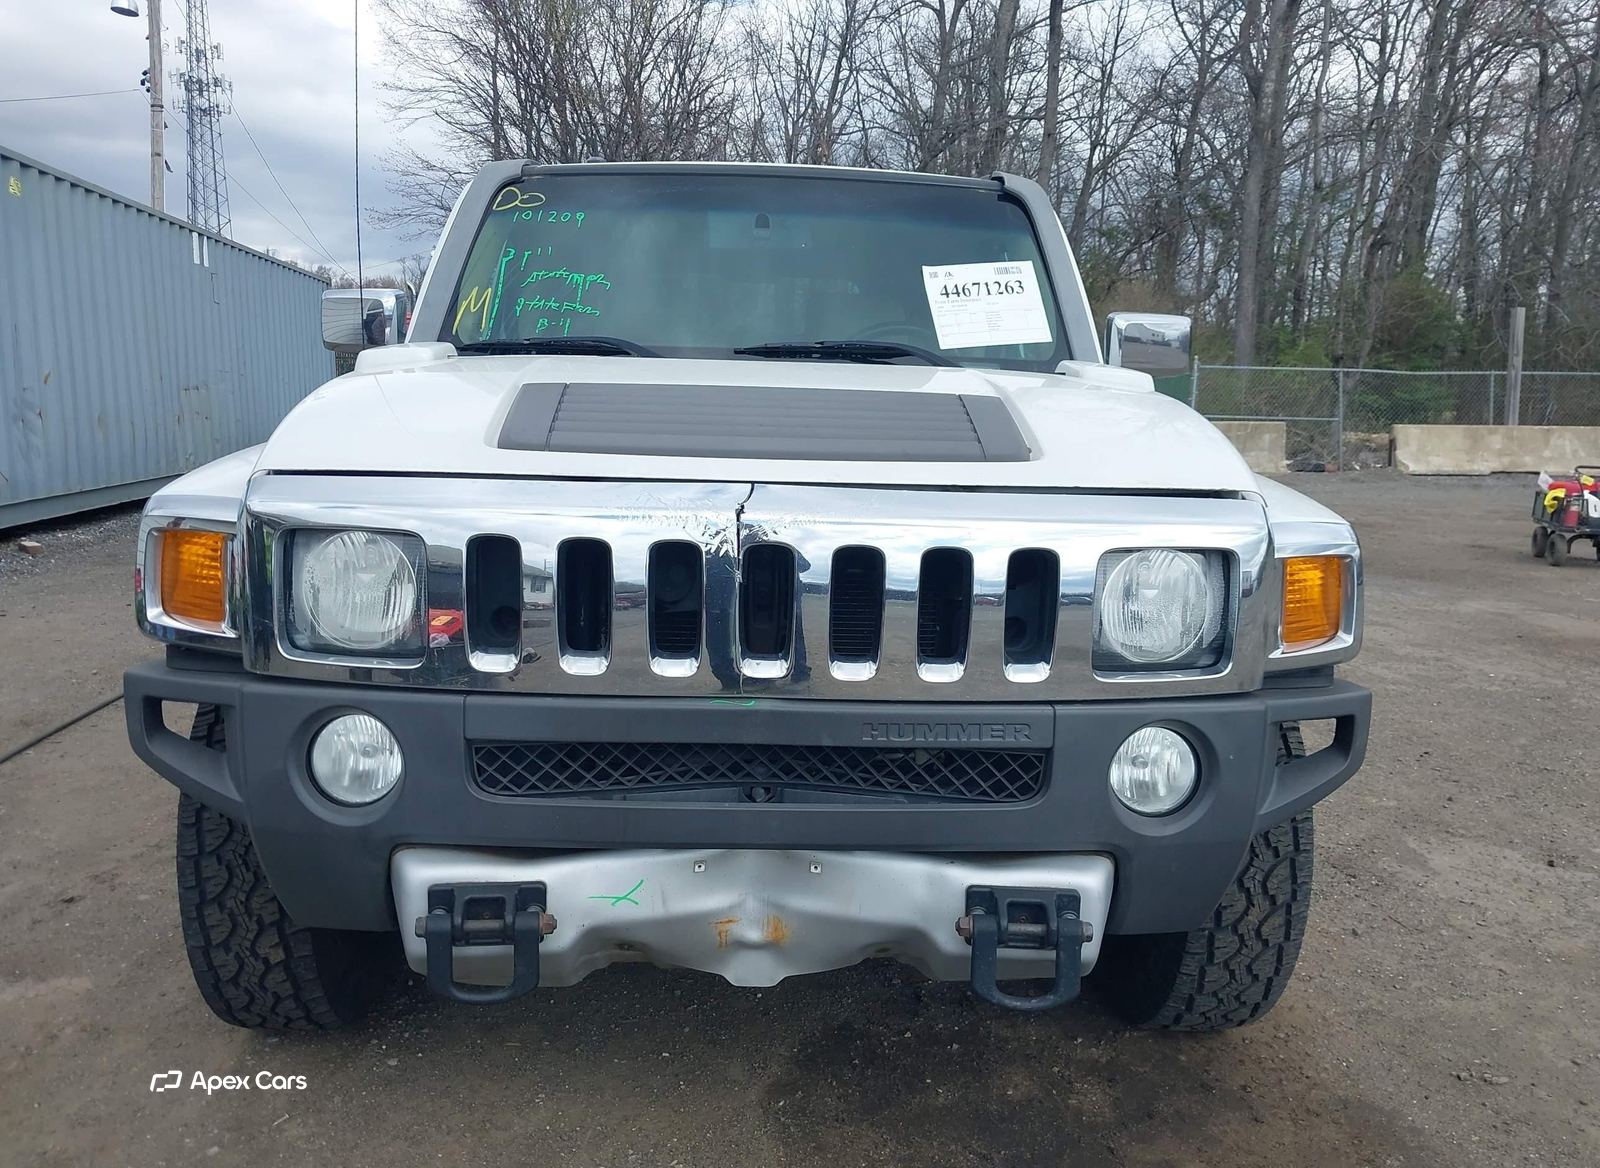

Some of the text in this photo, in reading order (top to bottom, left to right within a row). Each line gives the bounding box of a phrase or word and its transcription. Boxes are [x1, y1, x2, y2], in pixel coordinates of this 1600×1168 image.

[513, 210, 586, 228] 101209
[940, 280, 1025, 299] 44671263
[862, 723, 1032, 741] HUMMER
